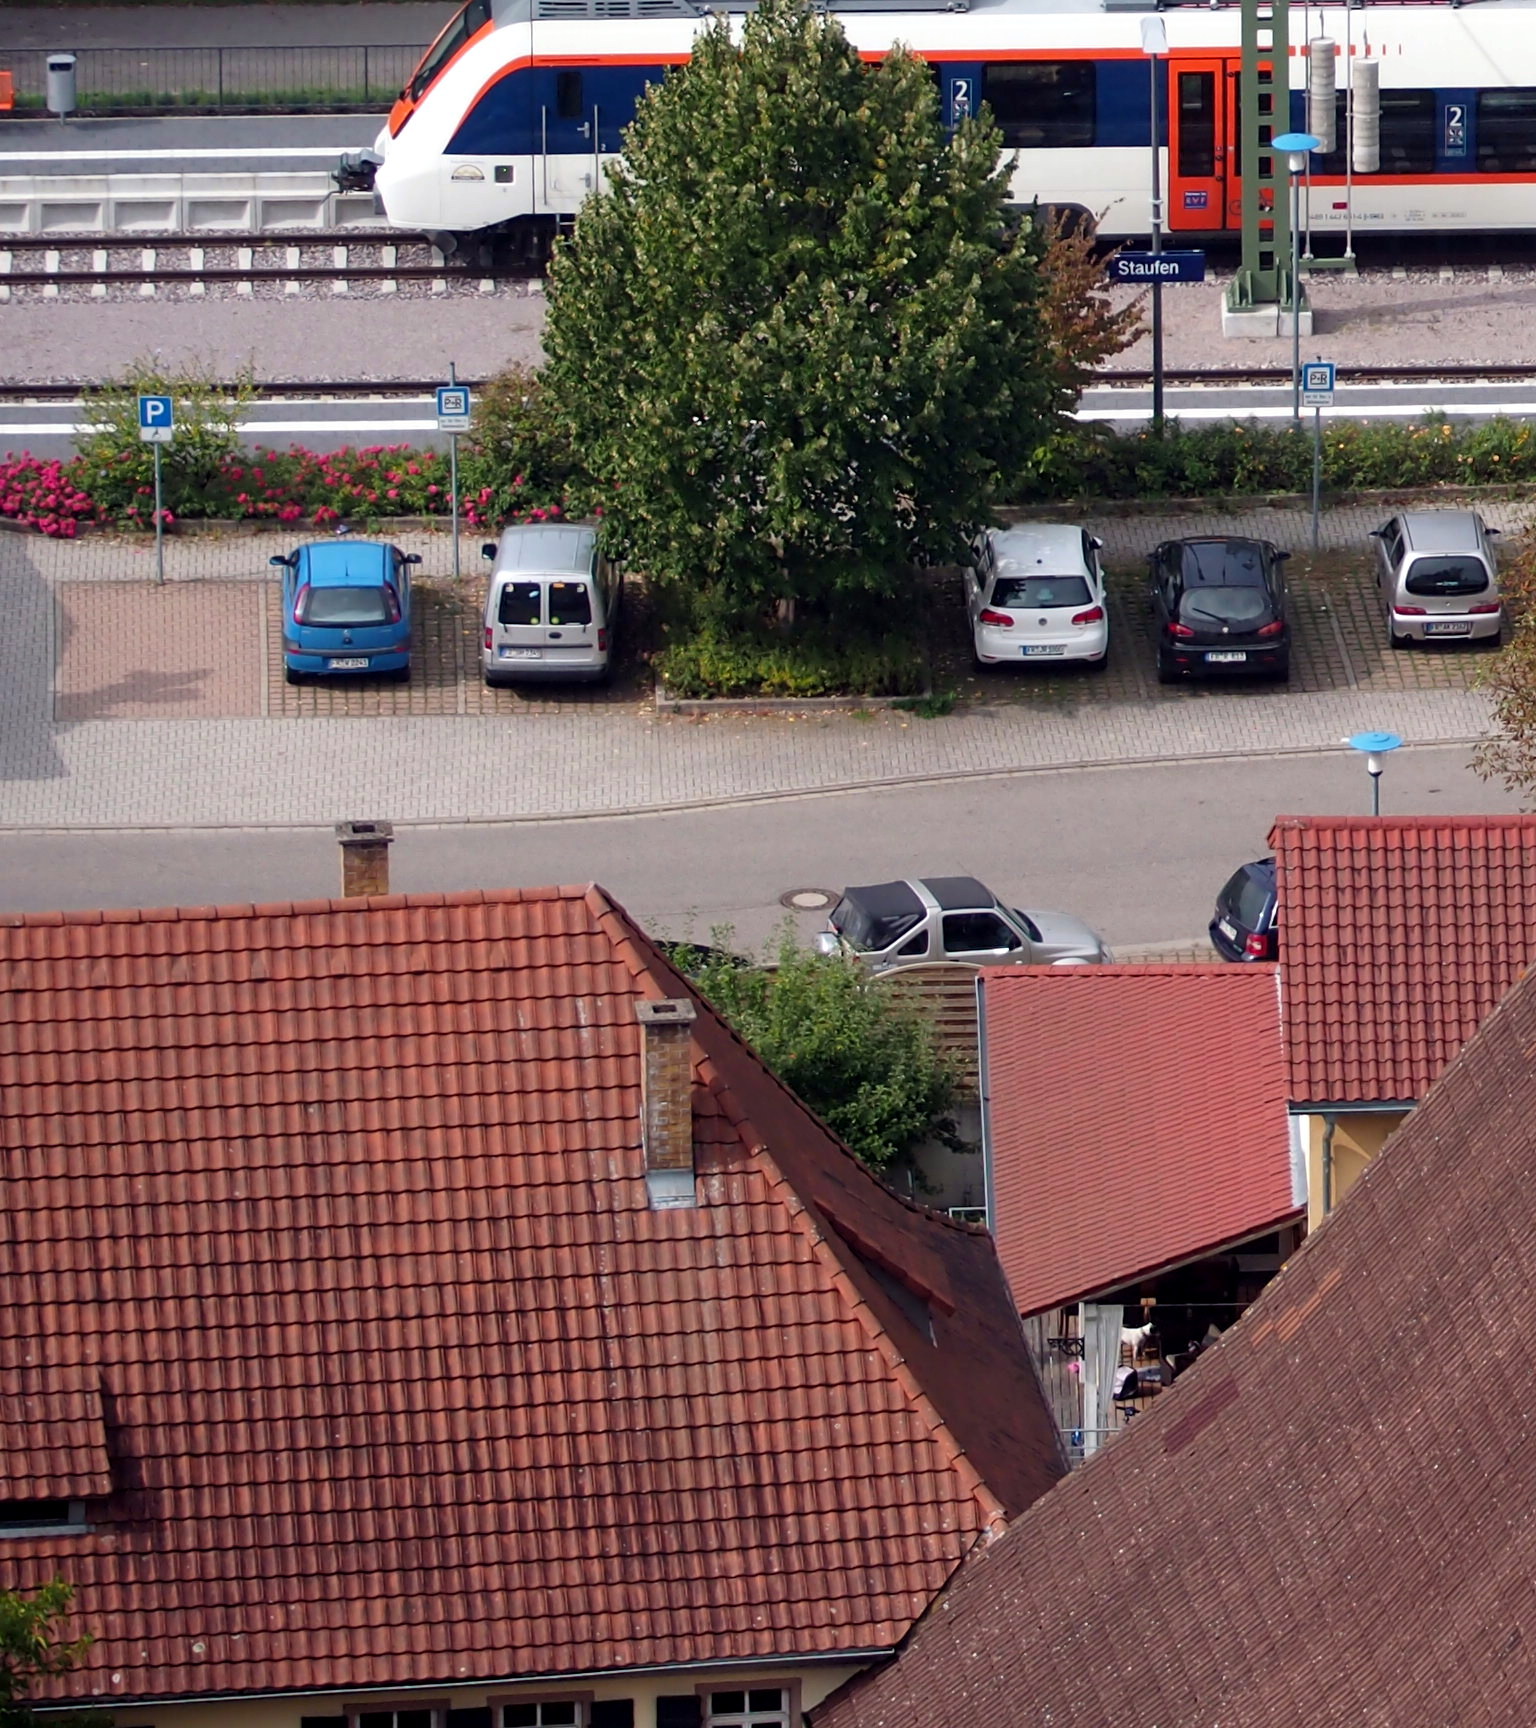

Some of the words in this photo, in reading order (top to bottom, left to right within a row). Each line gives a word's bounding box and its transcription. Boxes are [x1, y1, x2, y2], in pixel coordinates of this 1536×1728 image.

[955, 80, 968, 101] 2
[1450, 107, 1462, 127] 2
[1118, 260, 1179, 275] Staufen
[146, 401, 164, 424] P
